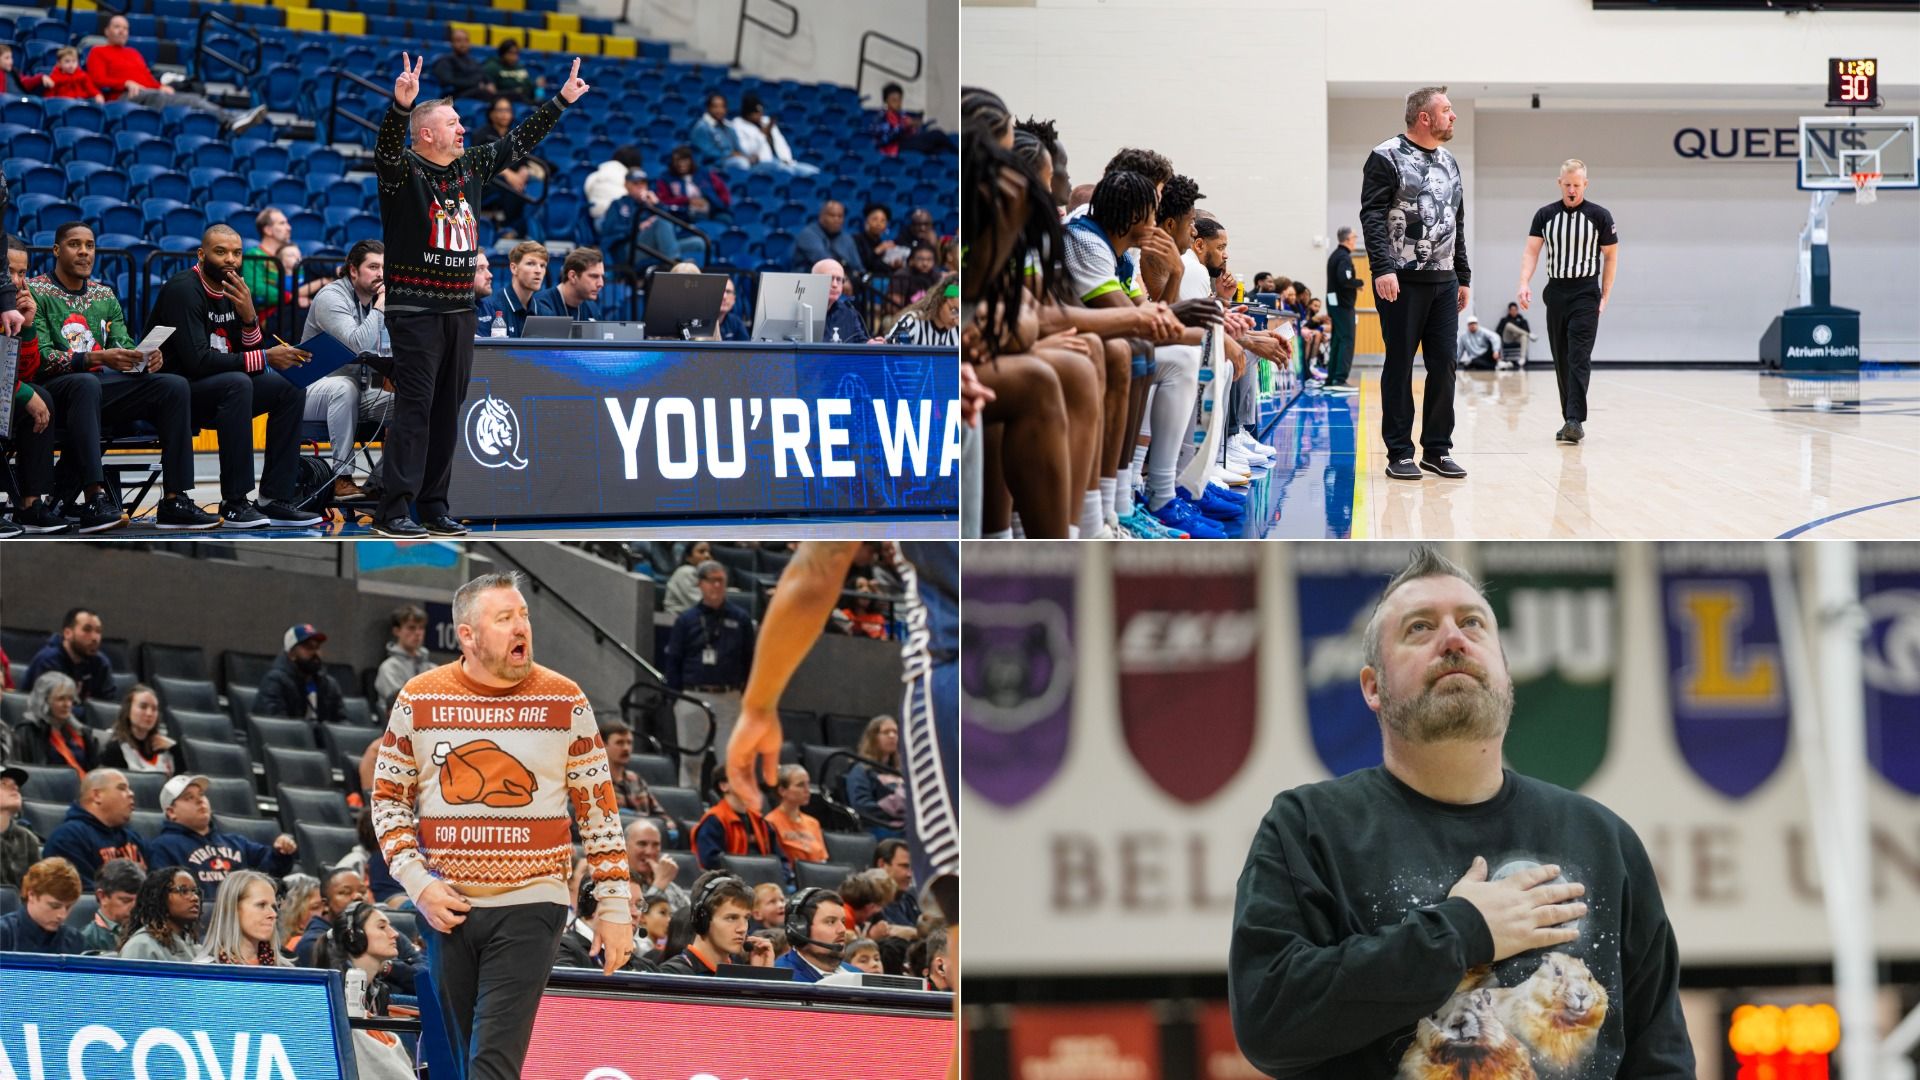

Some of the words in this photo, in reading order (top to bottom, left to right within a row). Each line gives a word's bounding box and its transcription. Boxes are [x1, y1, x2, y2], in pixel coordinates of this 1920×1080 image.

[1840, 75, 1869, 100] 30
[1673, 125, 1868, 160] QUEENS
[423, 251, 441, 265] WE
[445, 256, 465, 267] DEM
[1786, 345, 1825, 358] Atrium
[1824, 345, 1859, 357] Health
[604, 397, 856, 480] YOU'RE
[518, 706, 549, 722] ARE
[435, 826, 457, 842] FOR
[460, 826, 530, 844] QUITTERS
